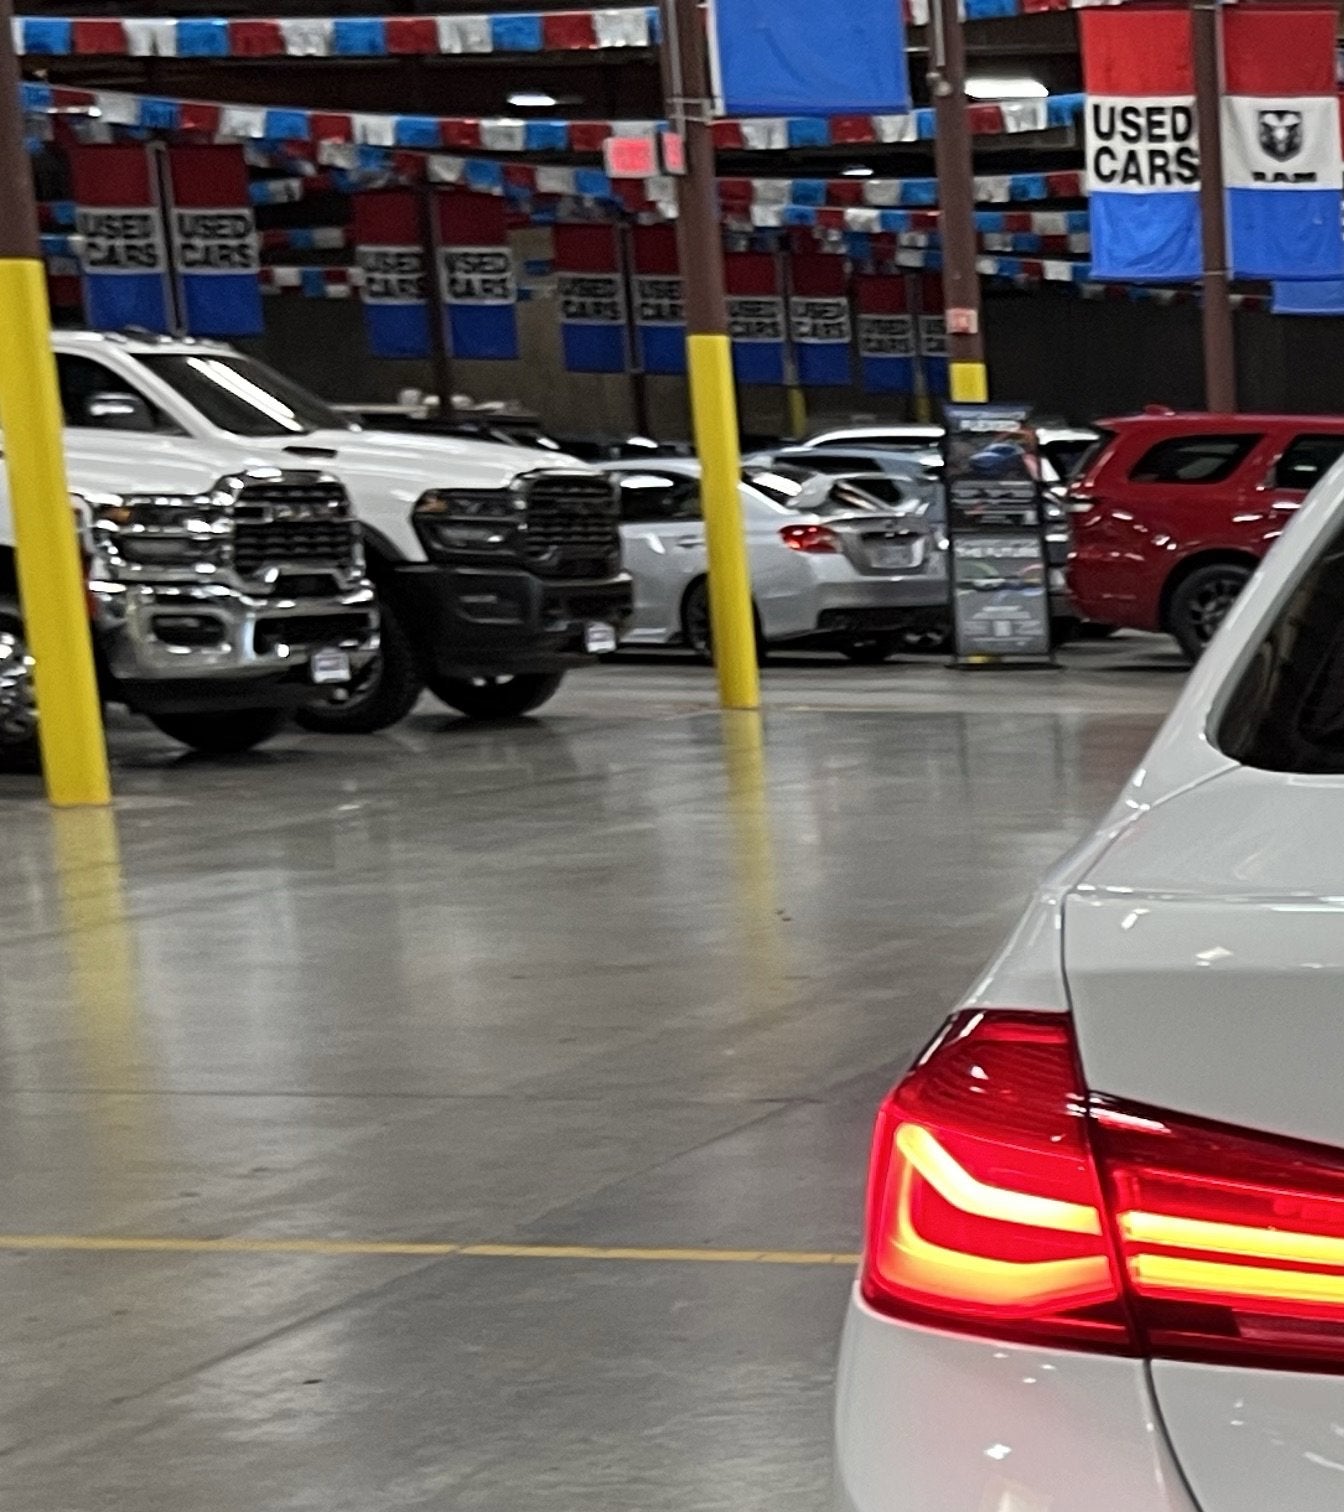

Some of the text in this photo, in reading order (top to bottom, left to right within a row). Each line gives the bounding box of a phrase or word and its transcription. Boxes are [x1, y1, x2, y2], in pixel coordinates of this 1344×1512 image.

[1093, 104, 1192, 144] USED
[1094, 146, 1200, 185] CARS
[178, 214, 249, 239] USED
[86, 242, 158, 267] CARS
[181, 243, 252, 267] CARS
